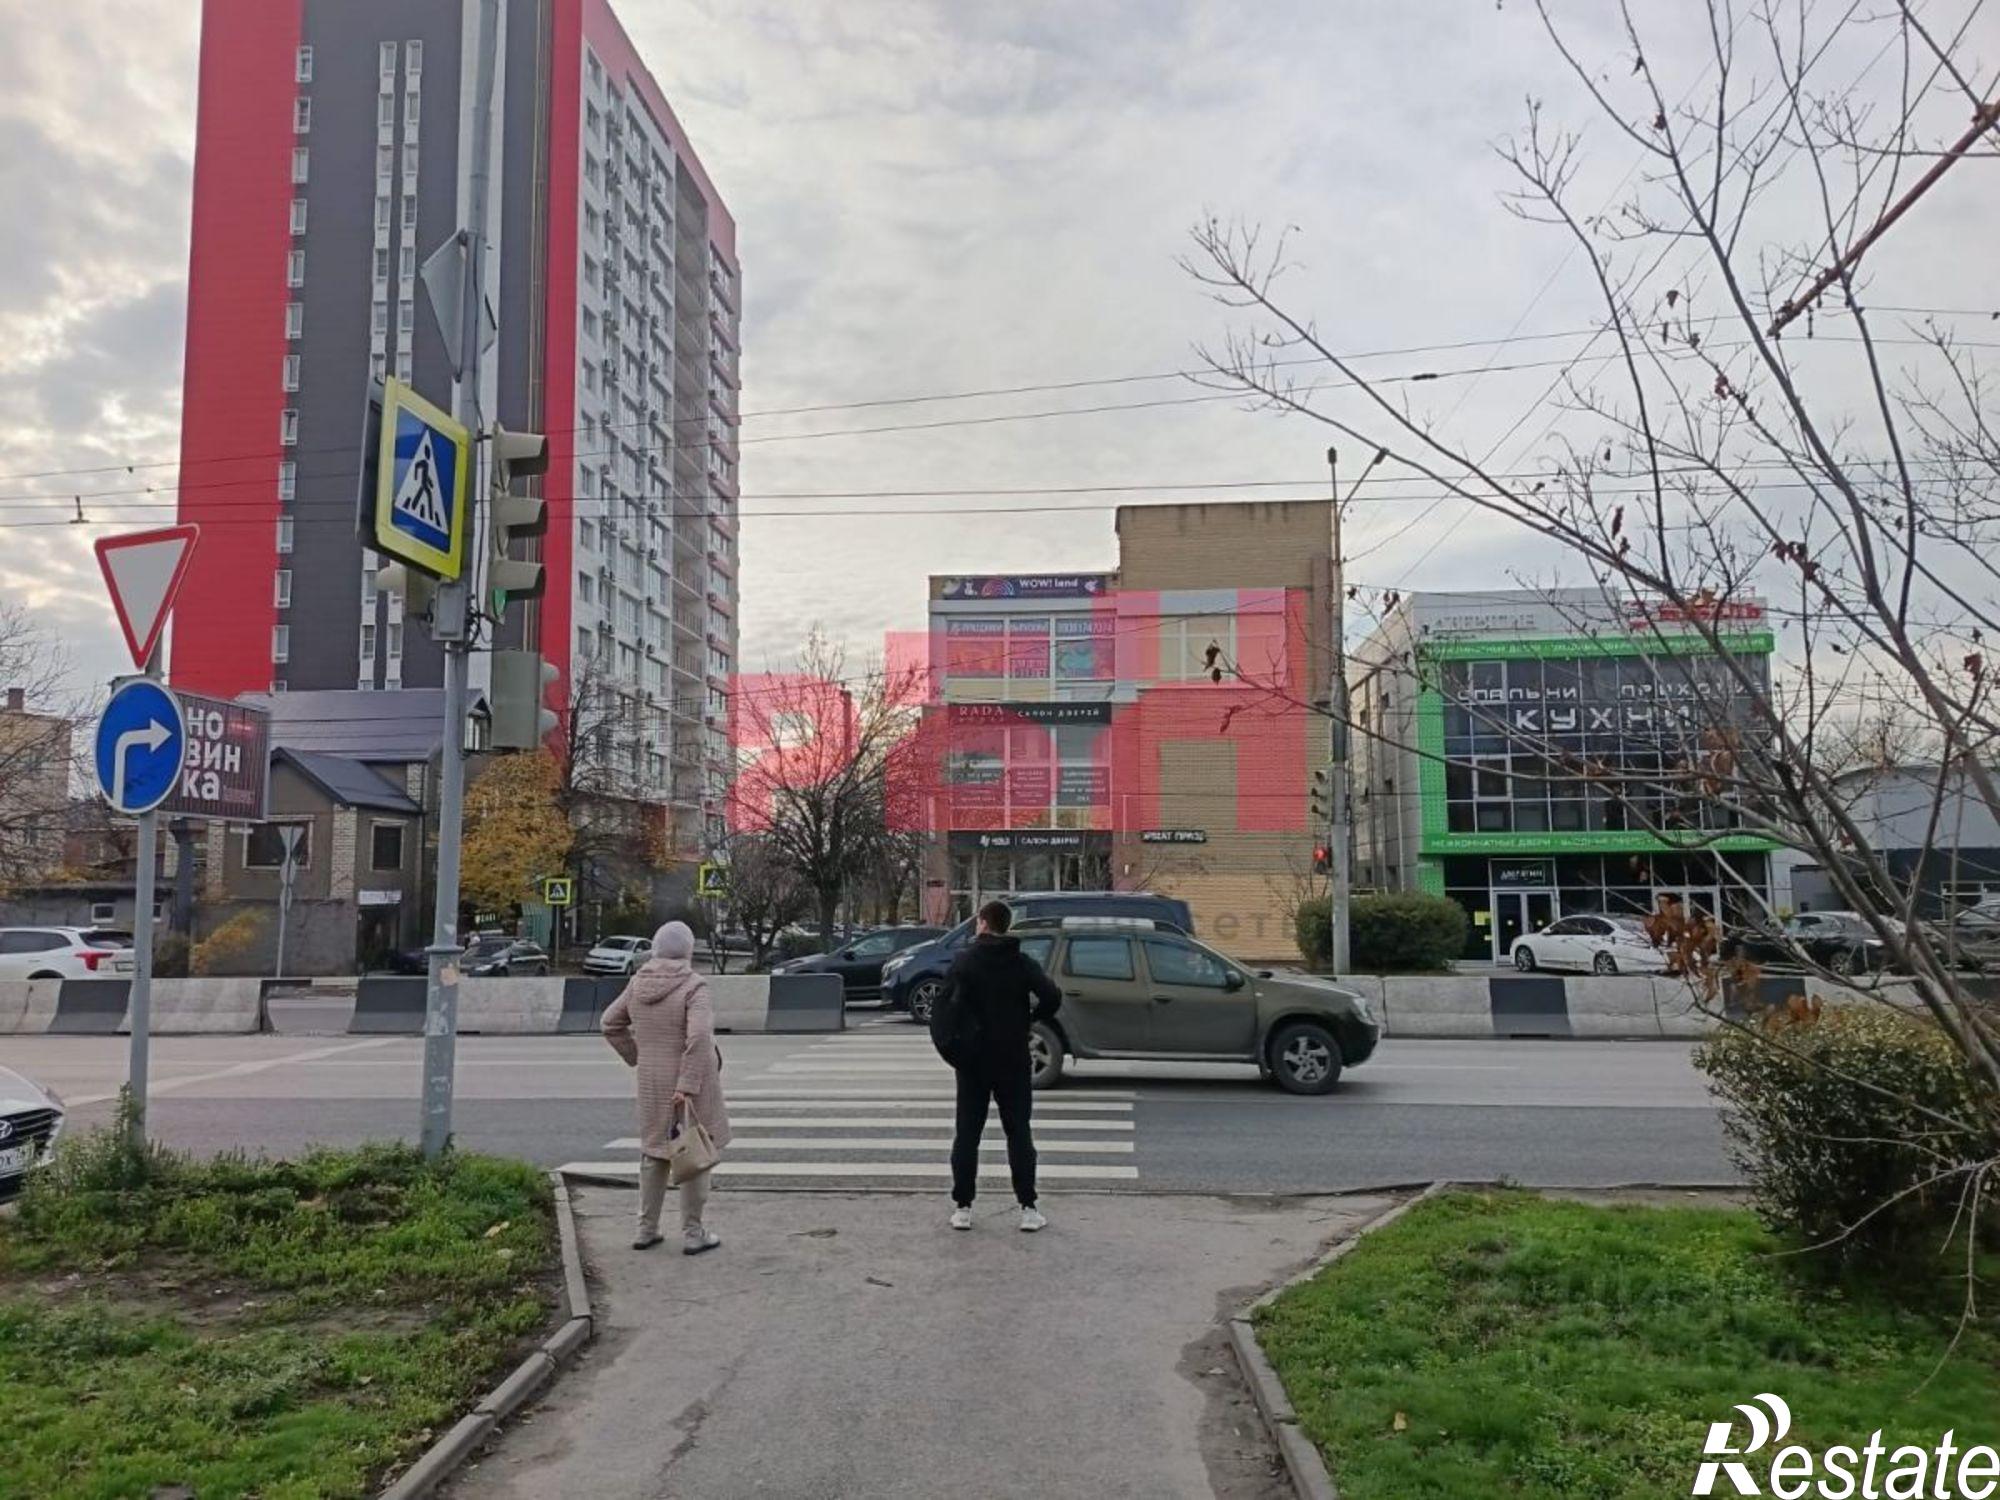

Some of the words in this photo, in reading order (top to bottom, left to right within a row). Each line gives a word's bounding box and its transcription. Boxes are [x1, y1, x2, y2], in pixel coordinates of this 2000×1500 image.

[1019, 578, 1052, 588] WOW!
[1457, 687, 1577, 701] СПАЛЬНИ
[959, 705, 1004, 716] RADA
[1515, 706, 1691, 731] КУХНИ
